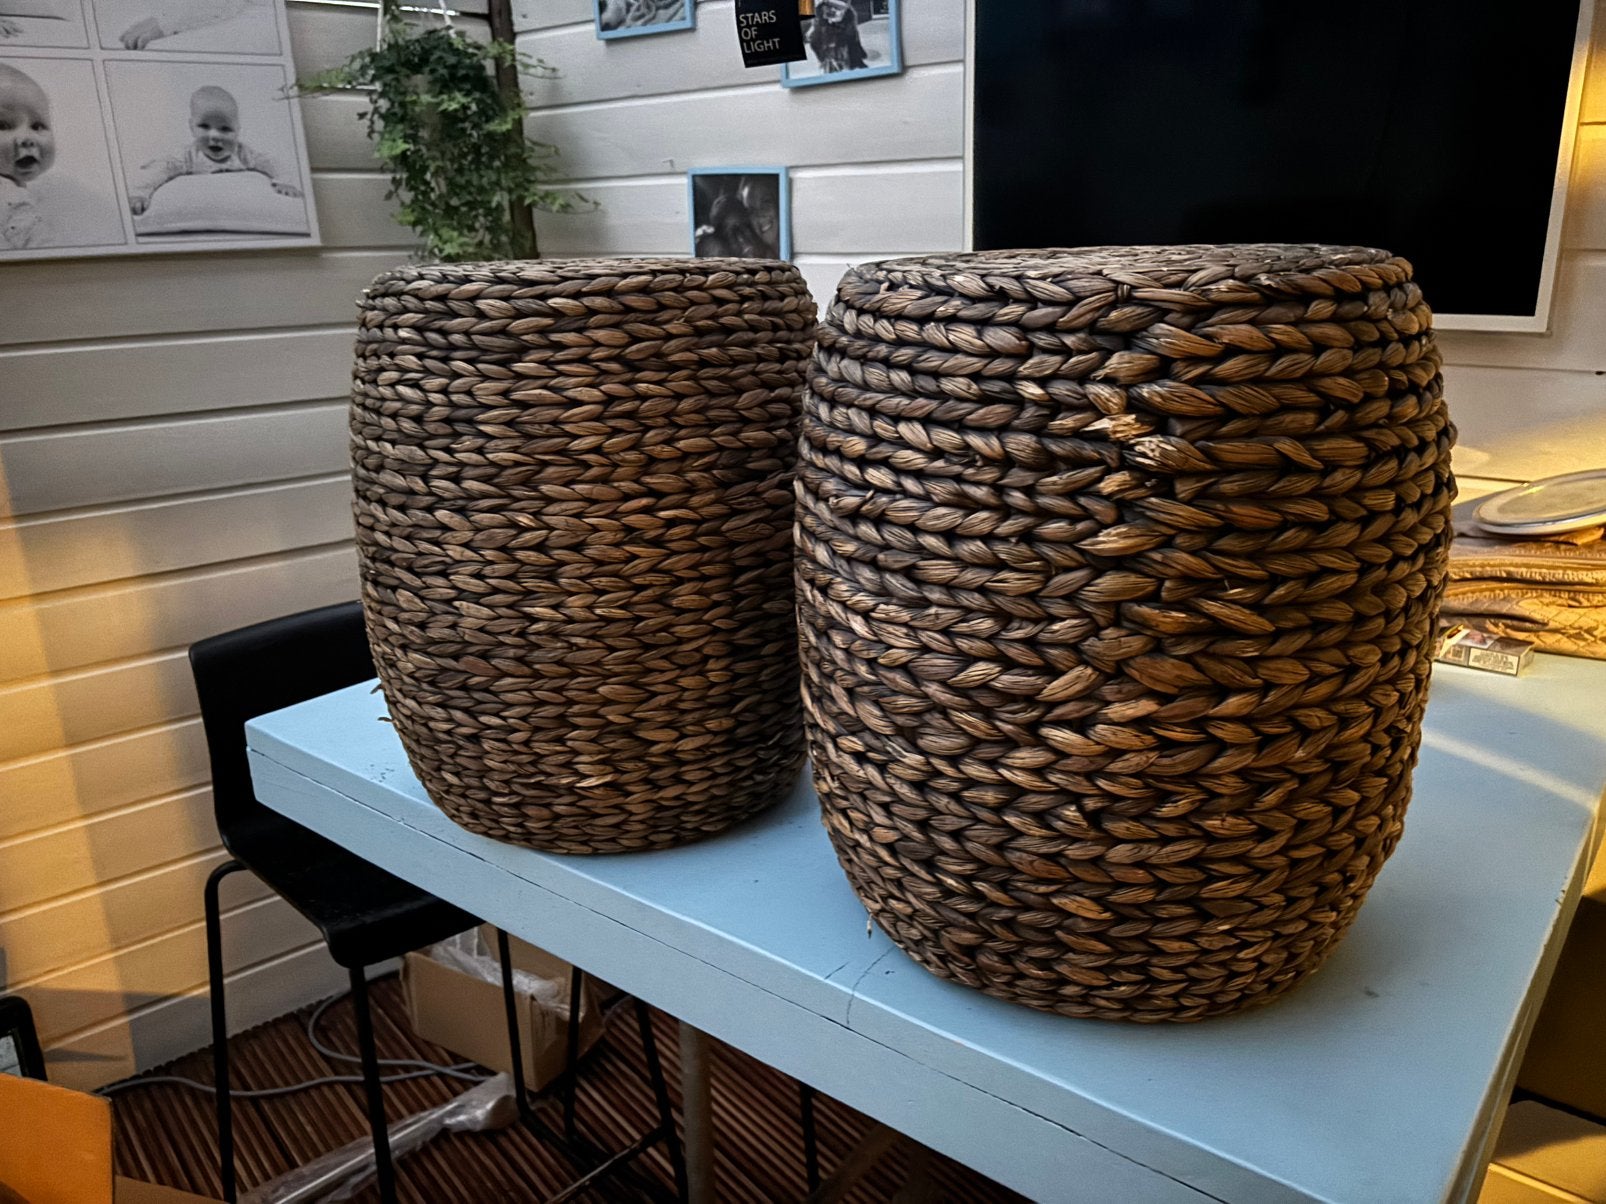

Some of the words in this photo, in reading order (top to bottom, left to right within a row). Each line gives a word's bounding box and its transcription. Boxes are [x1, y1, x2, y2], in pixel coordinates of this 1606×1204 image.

[739, 10, 777, 27] STARS
[741, 27, 758, 40] OF
[743, 38, 780, 54] LIGHT
